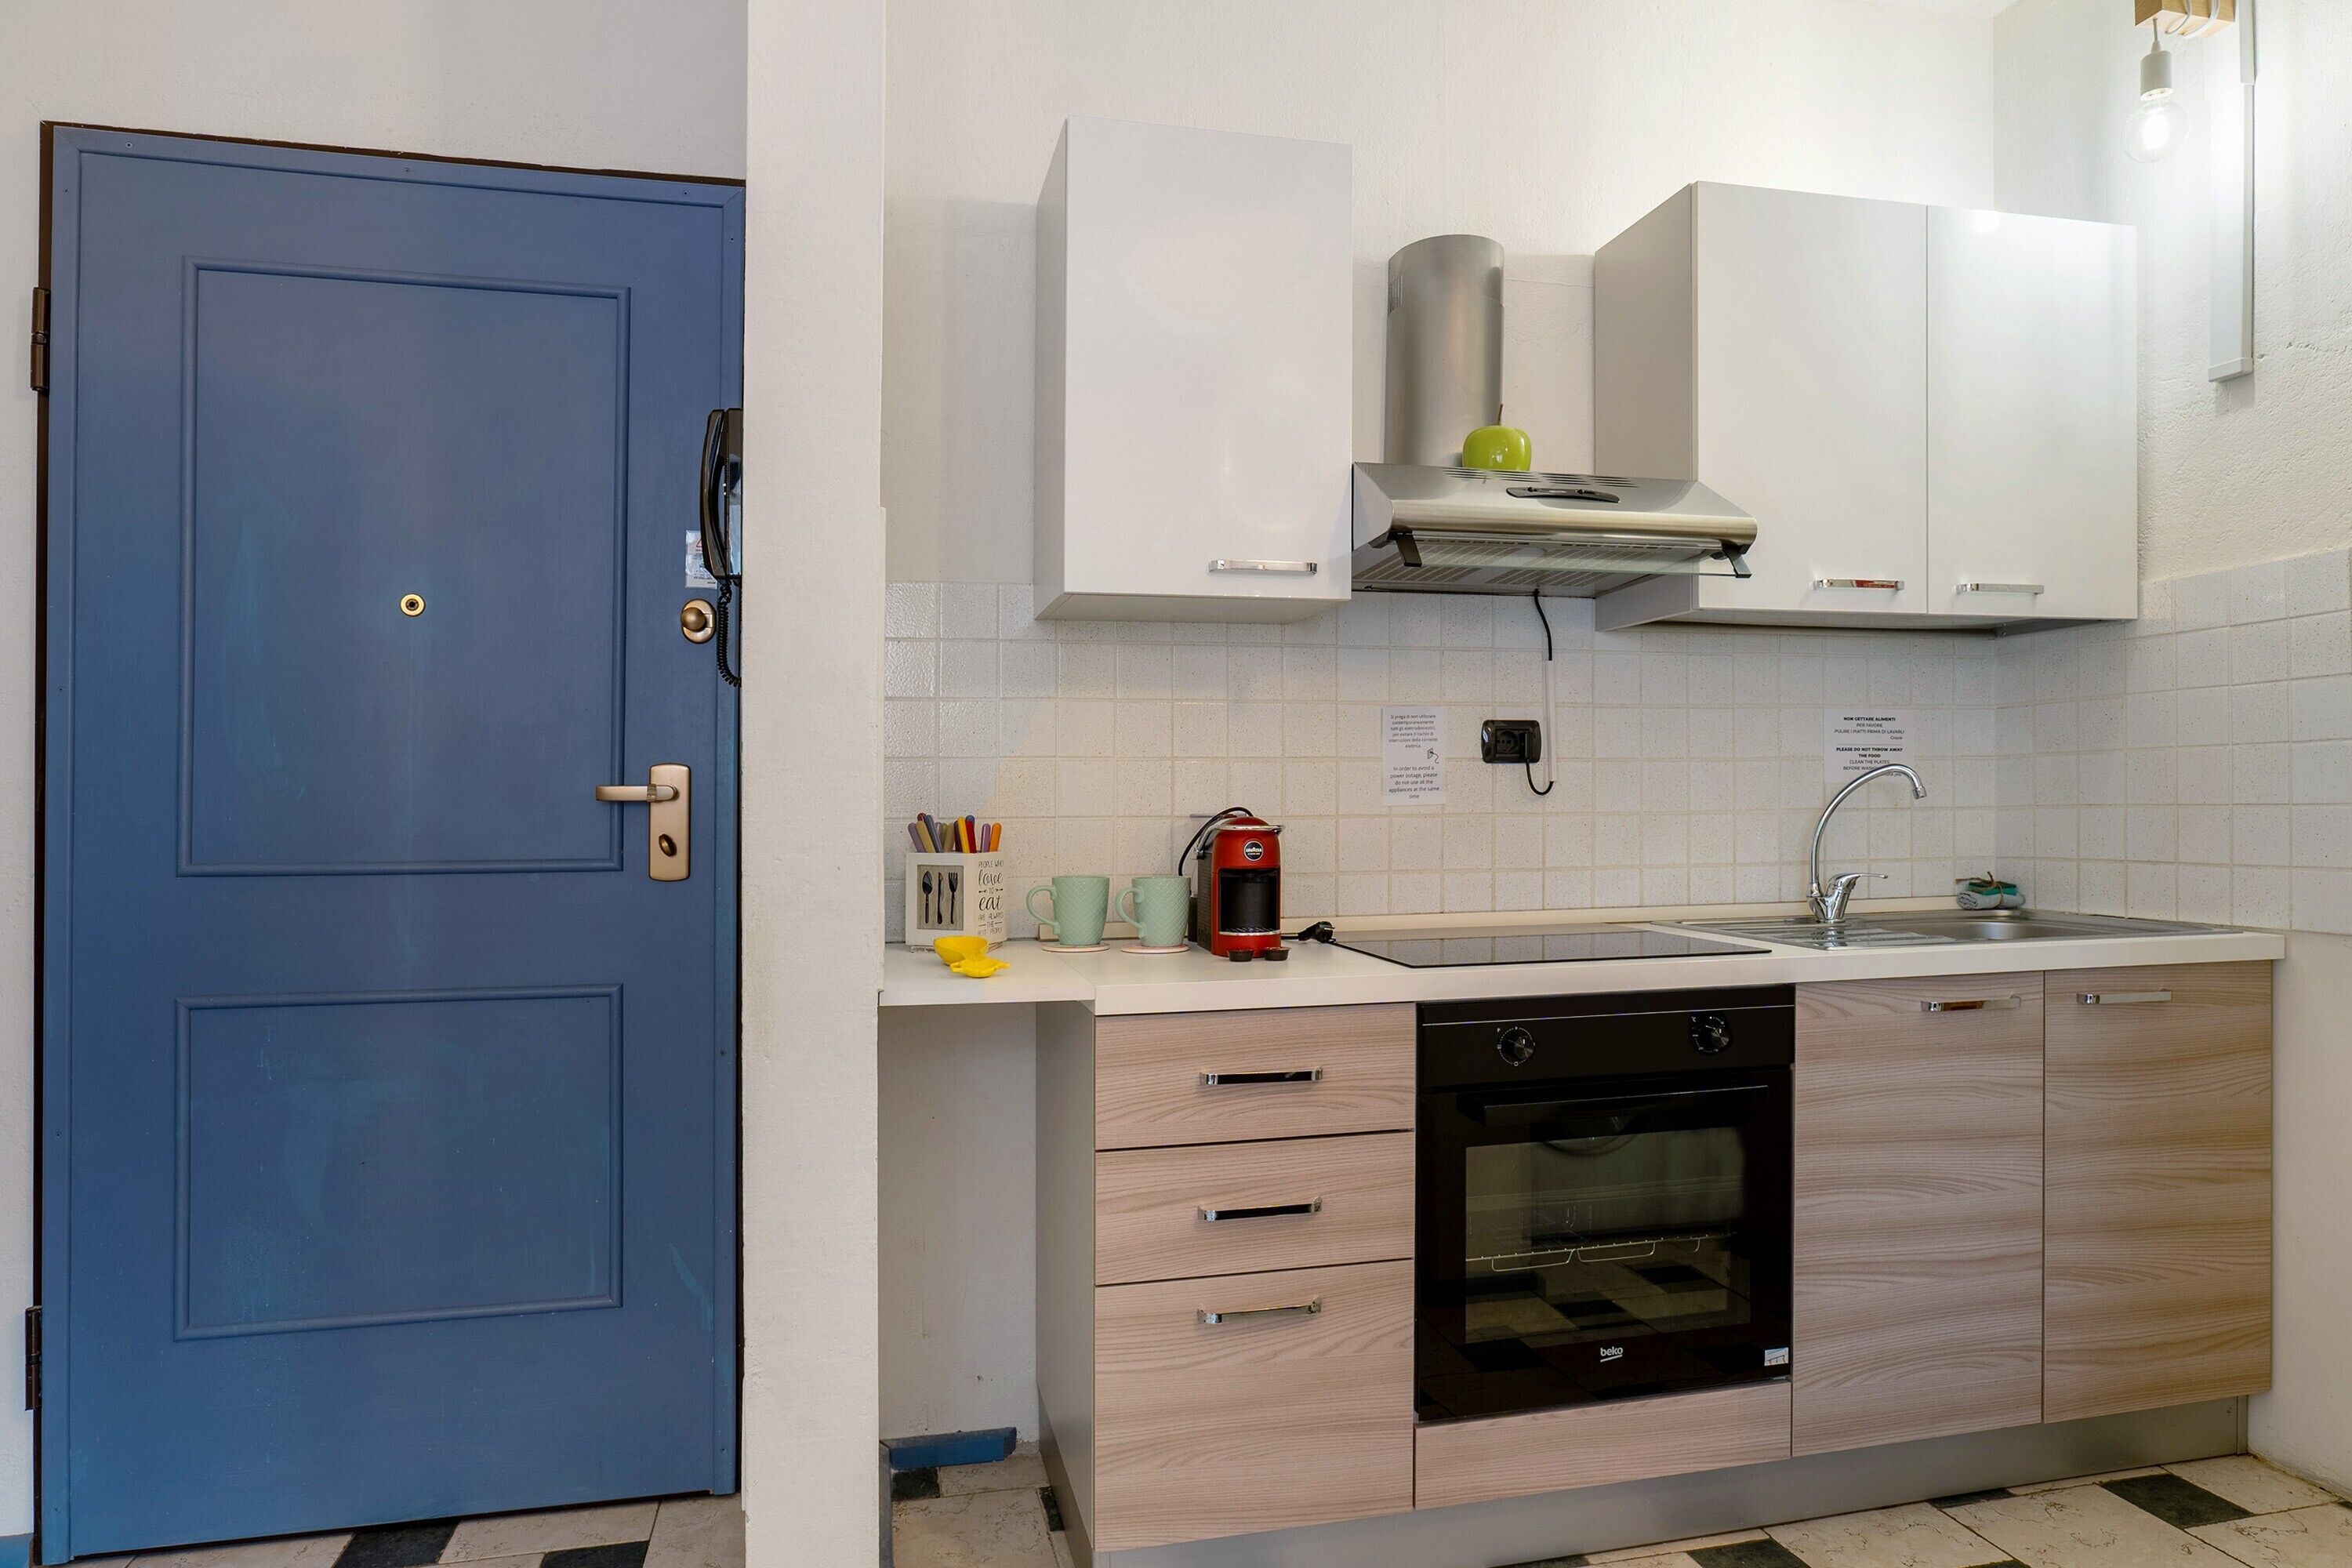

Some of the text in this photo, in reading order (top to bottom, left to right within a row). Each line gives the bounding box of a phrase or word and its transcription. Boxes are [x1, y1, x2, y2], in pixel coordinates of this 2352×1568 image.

[978, 869, 1004, 887] love
[978, 895, 1003, 911] eat
[1600, 1346, 1623, 1356] beko
